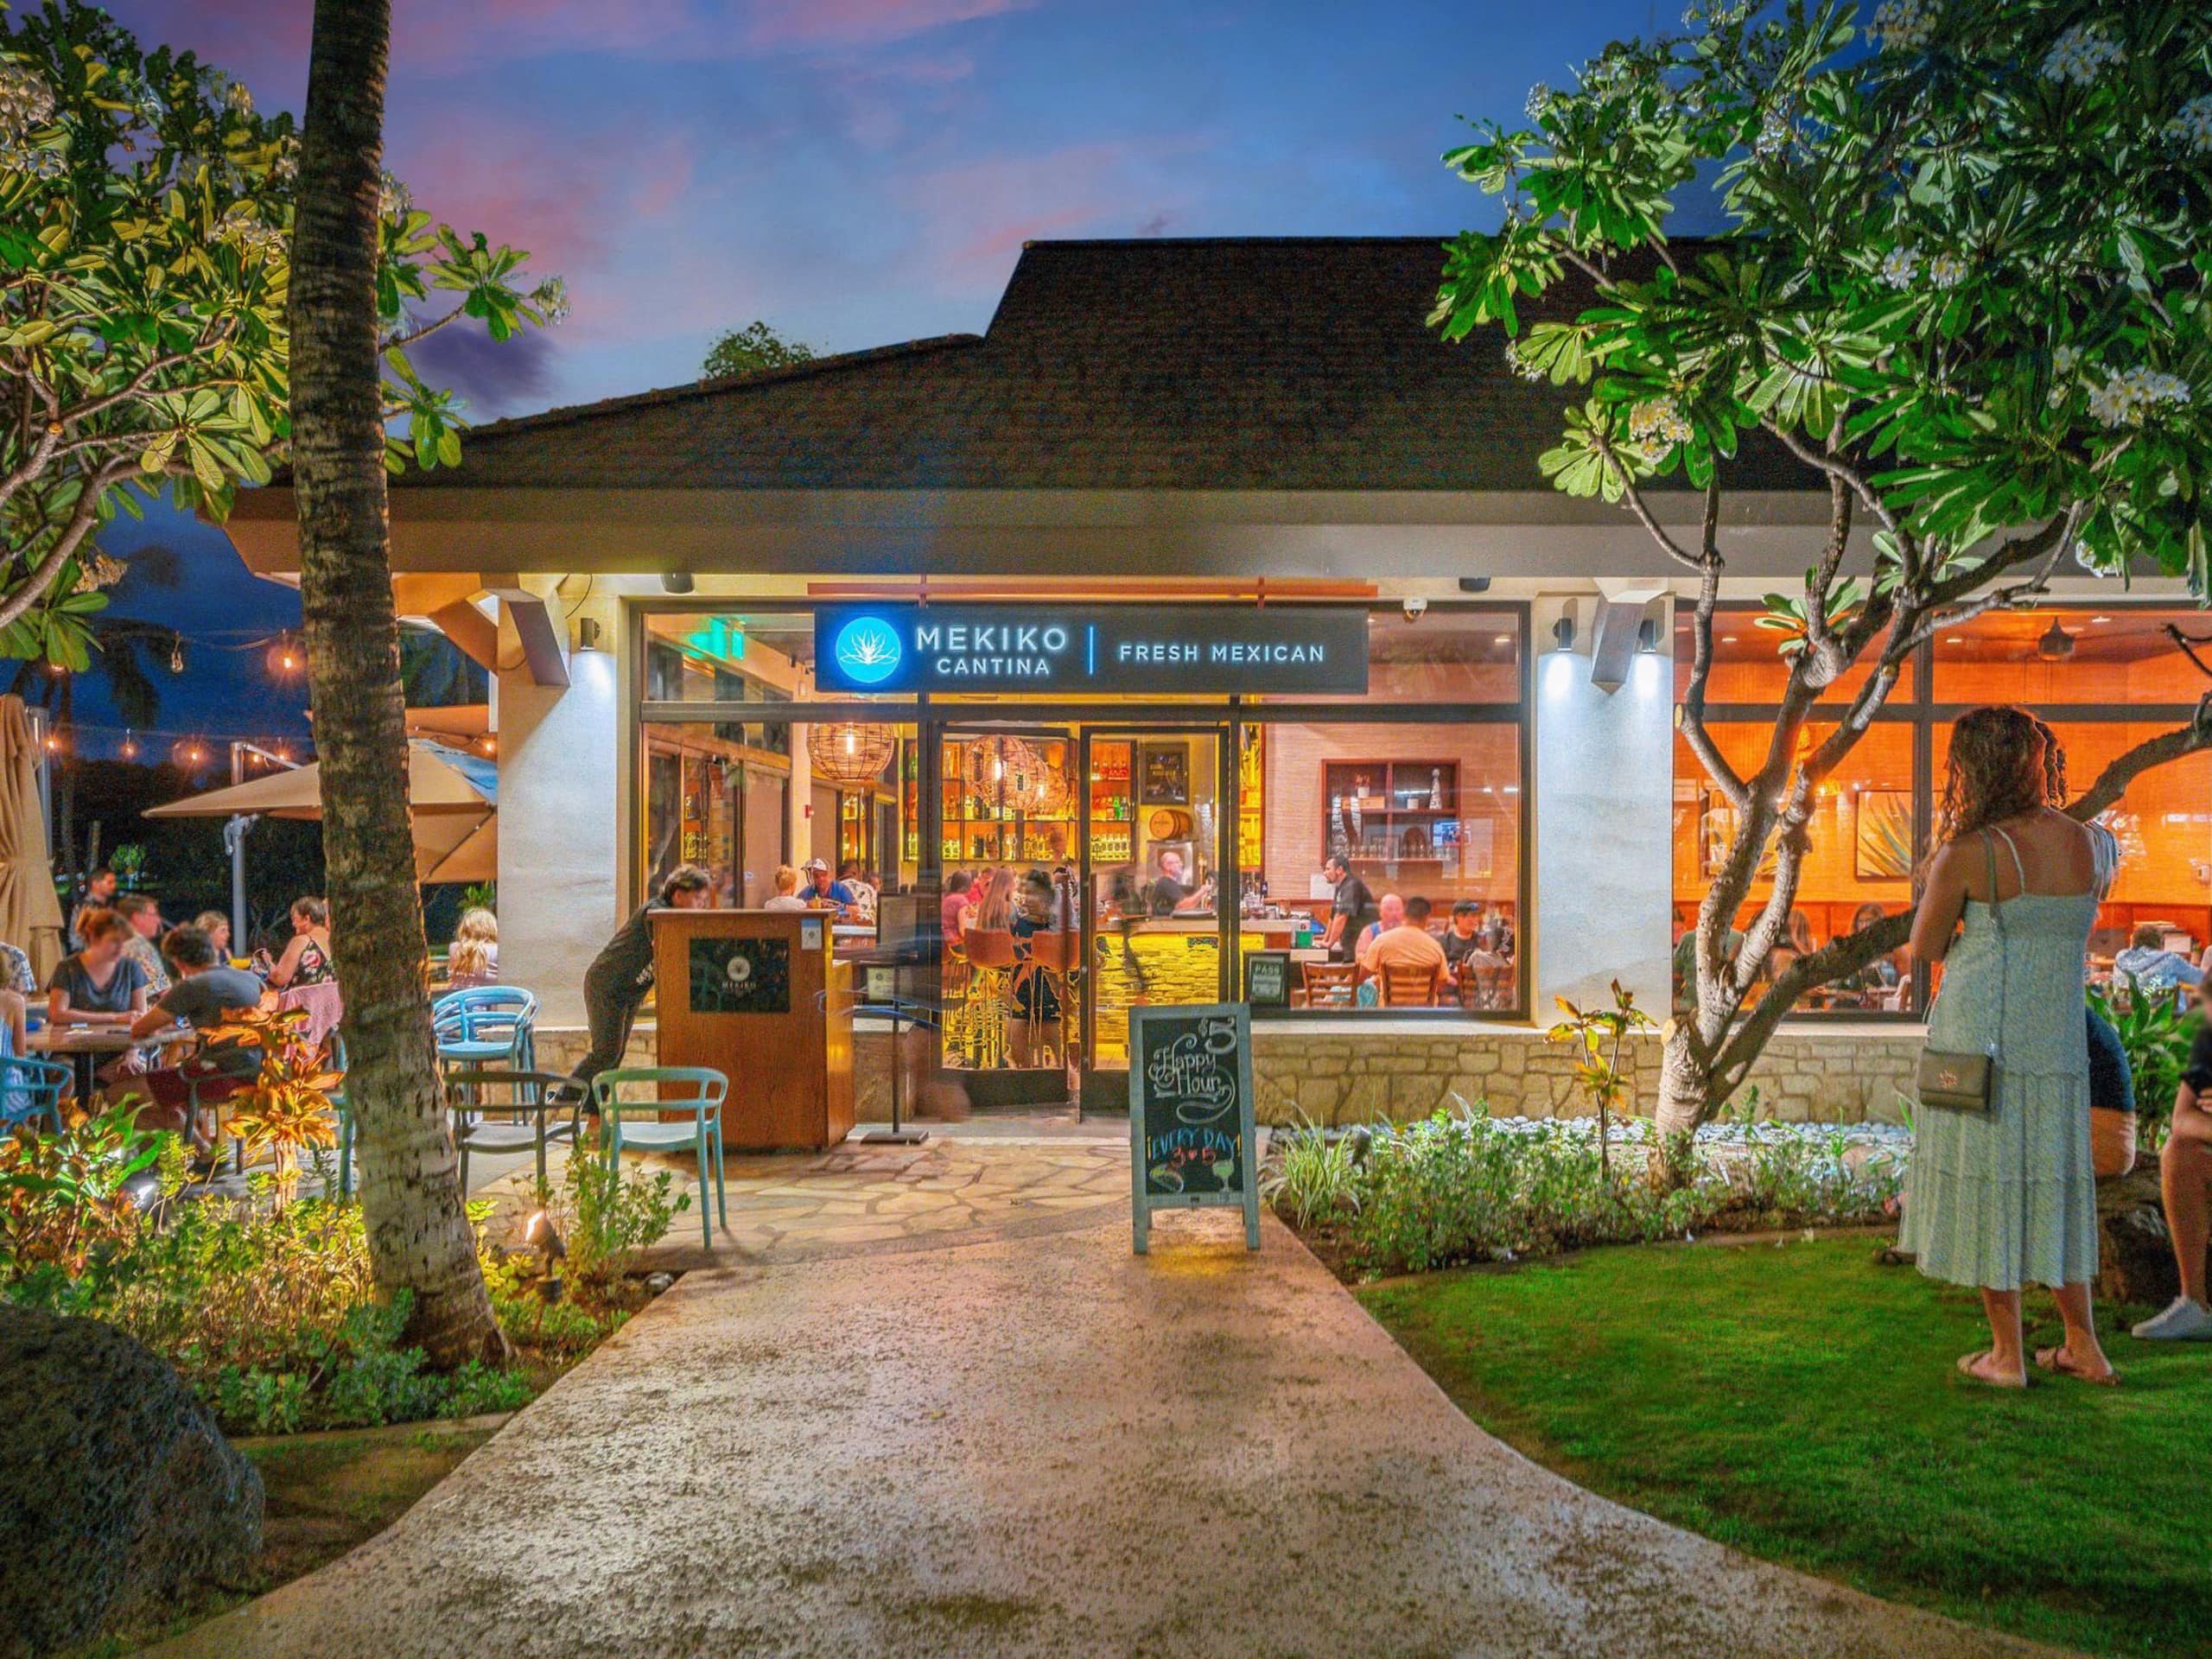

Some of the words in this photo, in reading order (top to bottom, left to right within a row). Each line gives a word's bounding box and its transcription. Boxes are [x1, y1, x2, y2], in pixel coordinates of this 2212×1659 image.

[916, 626, 1067, 652] MEKIKO
[1119, 644, 1198, 663] FRESH
[1211, 644, 1325, 663] MEXICAN
[936, 658, 1051, 676] CANTINA
[1149, 1033, 1217, 1087] Happy
